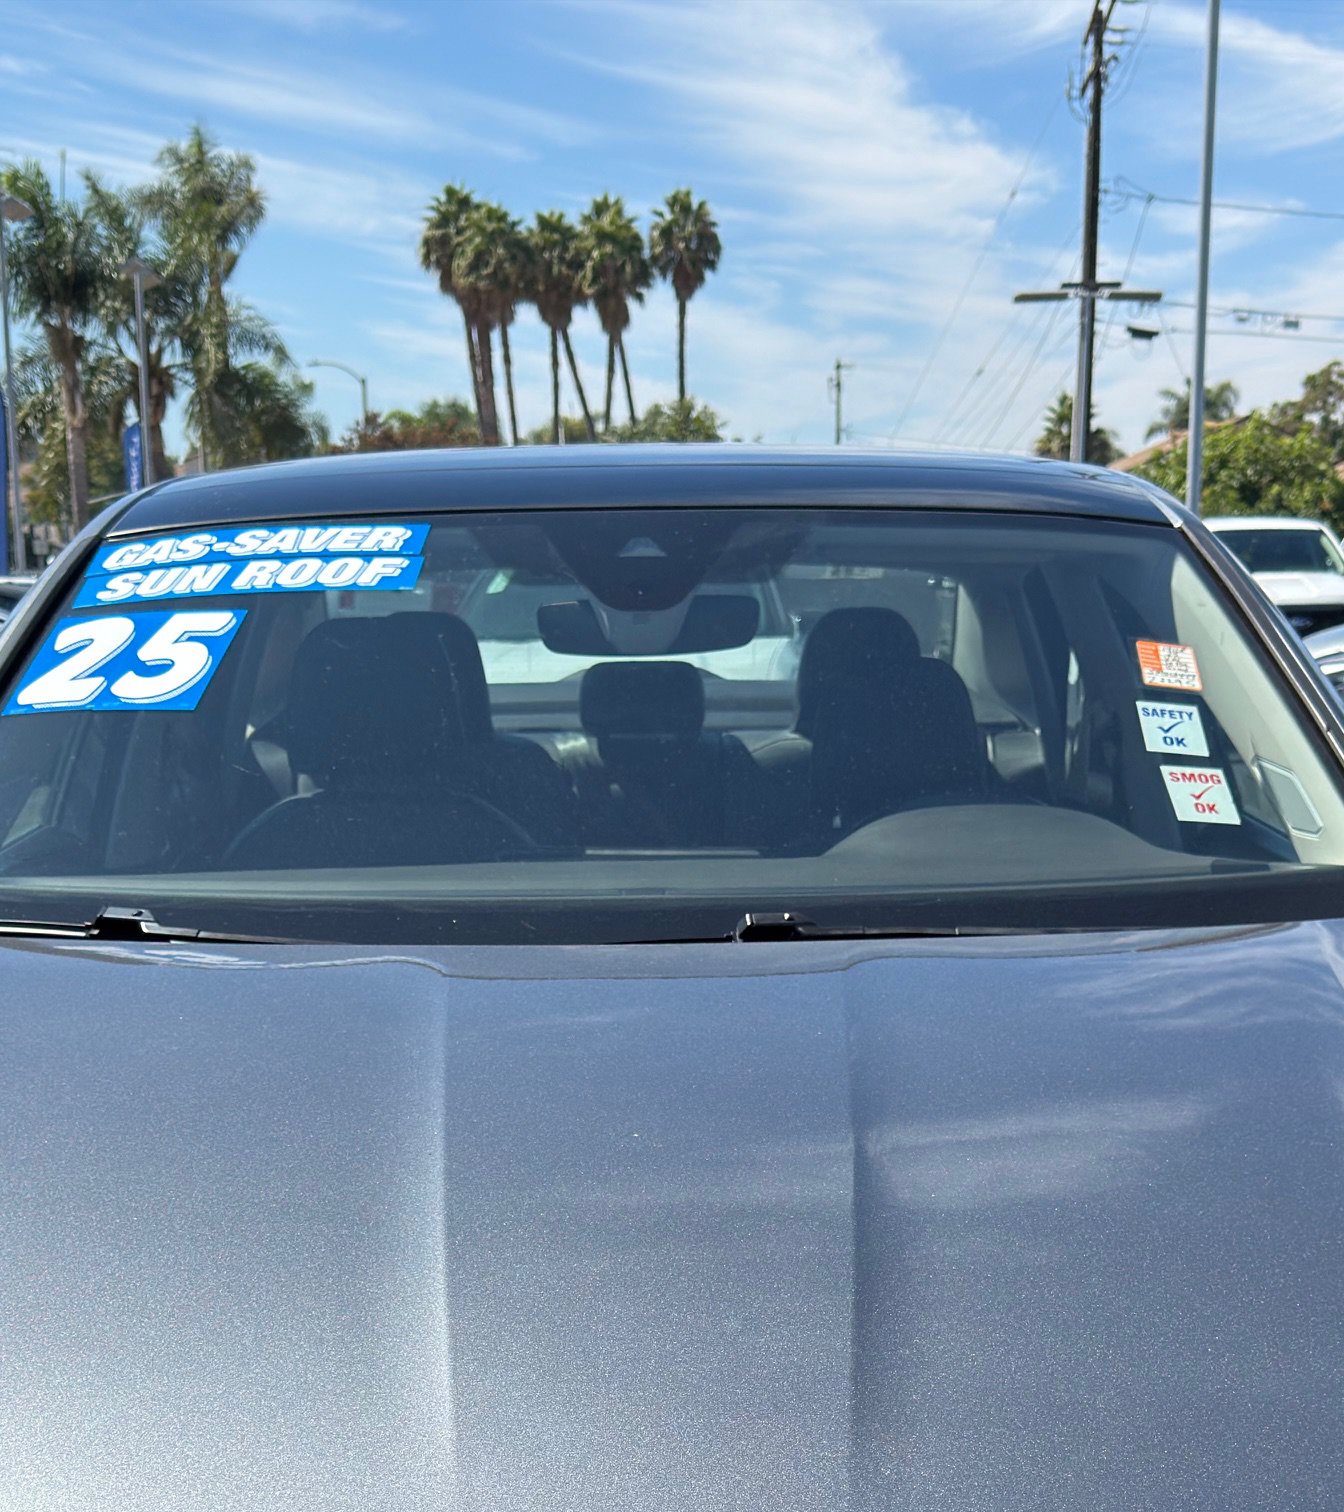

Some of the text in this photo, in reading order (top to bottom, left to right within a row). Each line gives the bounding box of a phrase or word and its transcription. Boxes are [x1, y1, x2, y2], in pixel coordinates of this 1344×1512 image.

[102, 525, 412, 571] GAS-SAVER
[96, 555, 410, 603] SUN ROOF
[16, 610, 237, 710] 25
[1141, 707, 1194, 721] SAFETY
[1162, 736, 1188, 748] OK
[1169, 771, 1223, 785] SMOG
[1194, 802, 1220, 815] OK
